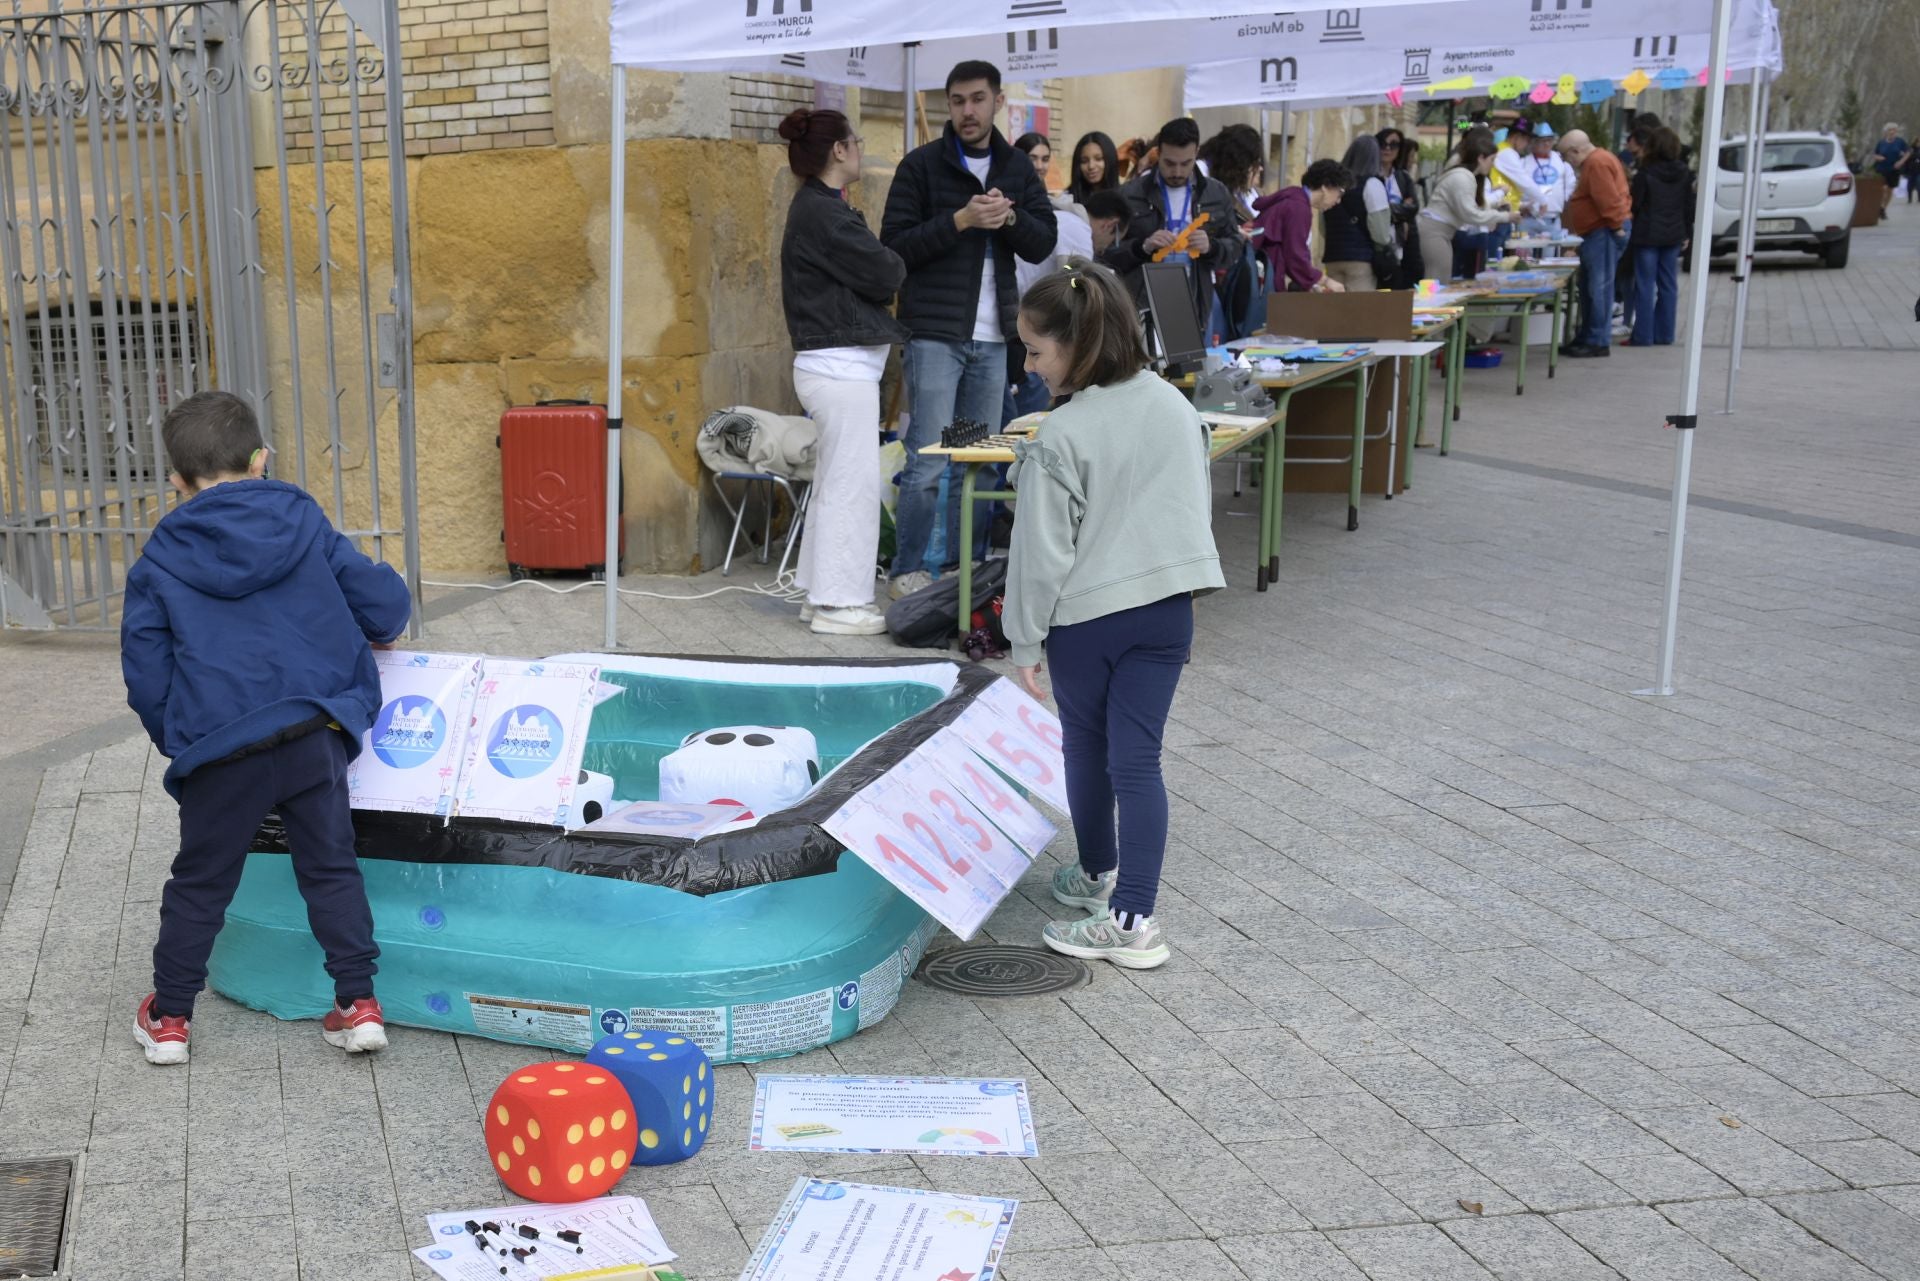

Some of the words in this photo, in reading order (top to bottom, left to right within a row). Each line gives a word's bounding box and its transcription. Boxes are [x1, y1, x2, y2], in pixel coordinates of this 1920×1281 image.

[778, 16, 813, 27] MURCIA
[746, 33, 776, 45] siempre
[1443, 48, 1515, 61] Ayuntamiento
[1261, 56, 1297, 83] m
[1443, 65, 1455, 74] de
[1458, 63, 1493, 73] Murcia
[987, 731, 1054, 785] 5
[963, 762, 1022, 816] 4
[929, 788, 992, 851] 3
[903, 812, 972, 876] 2
[875, 833, 948, 893] 1
[631, 1008, 656, 1017] WARNING!
